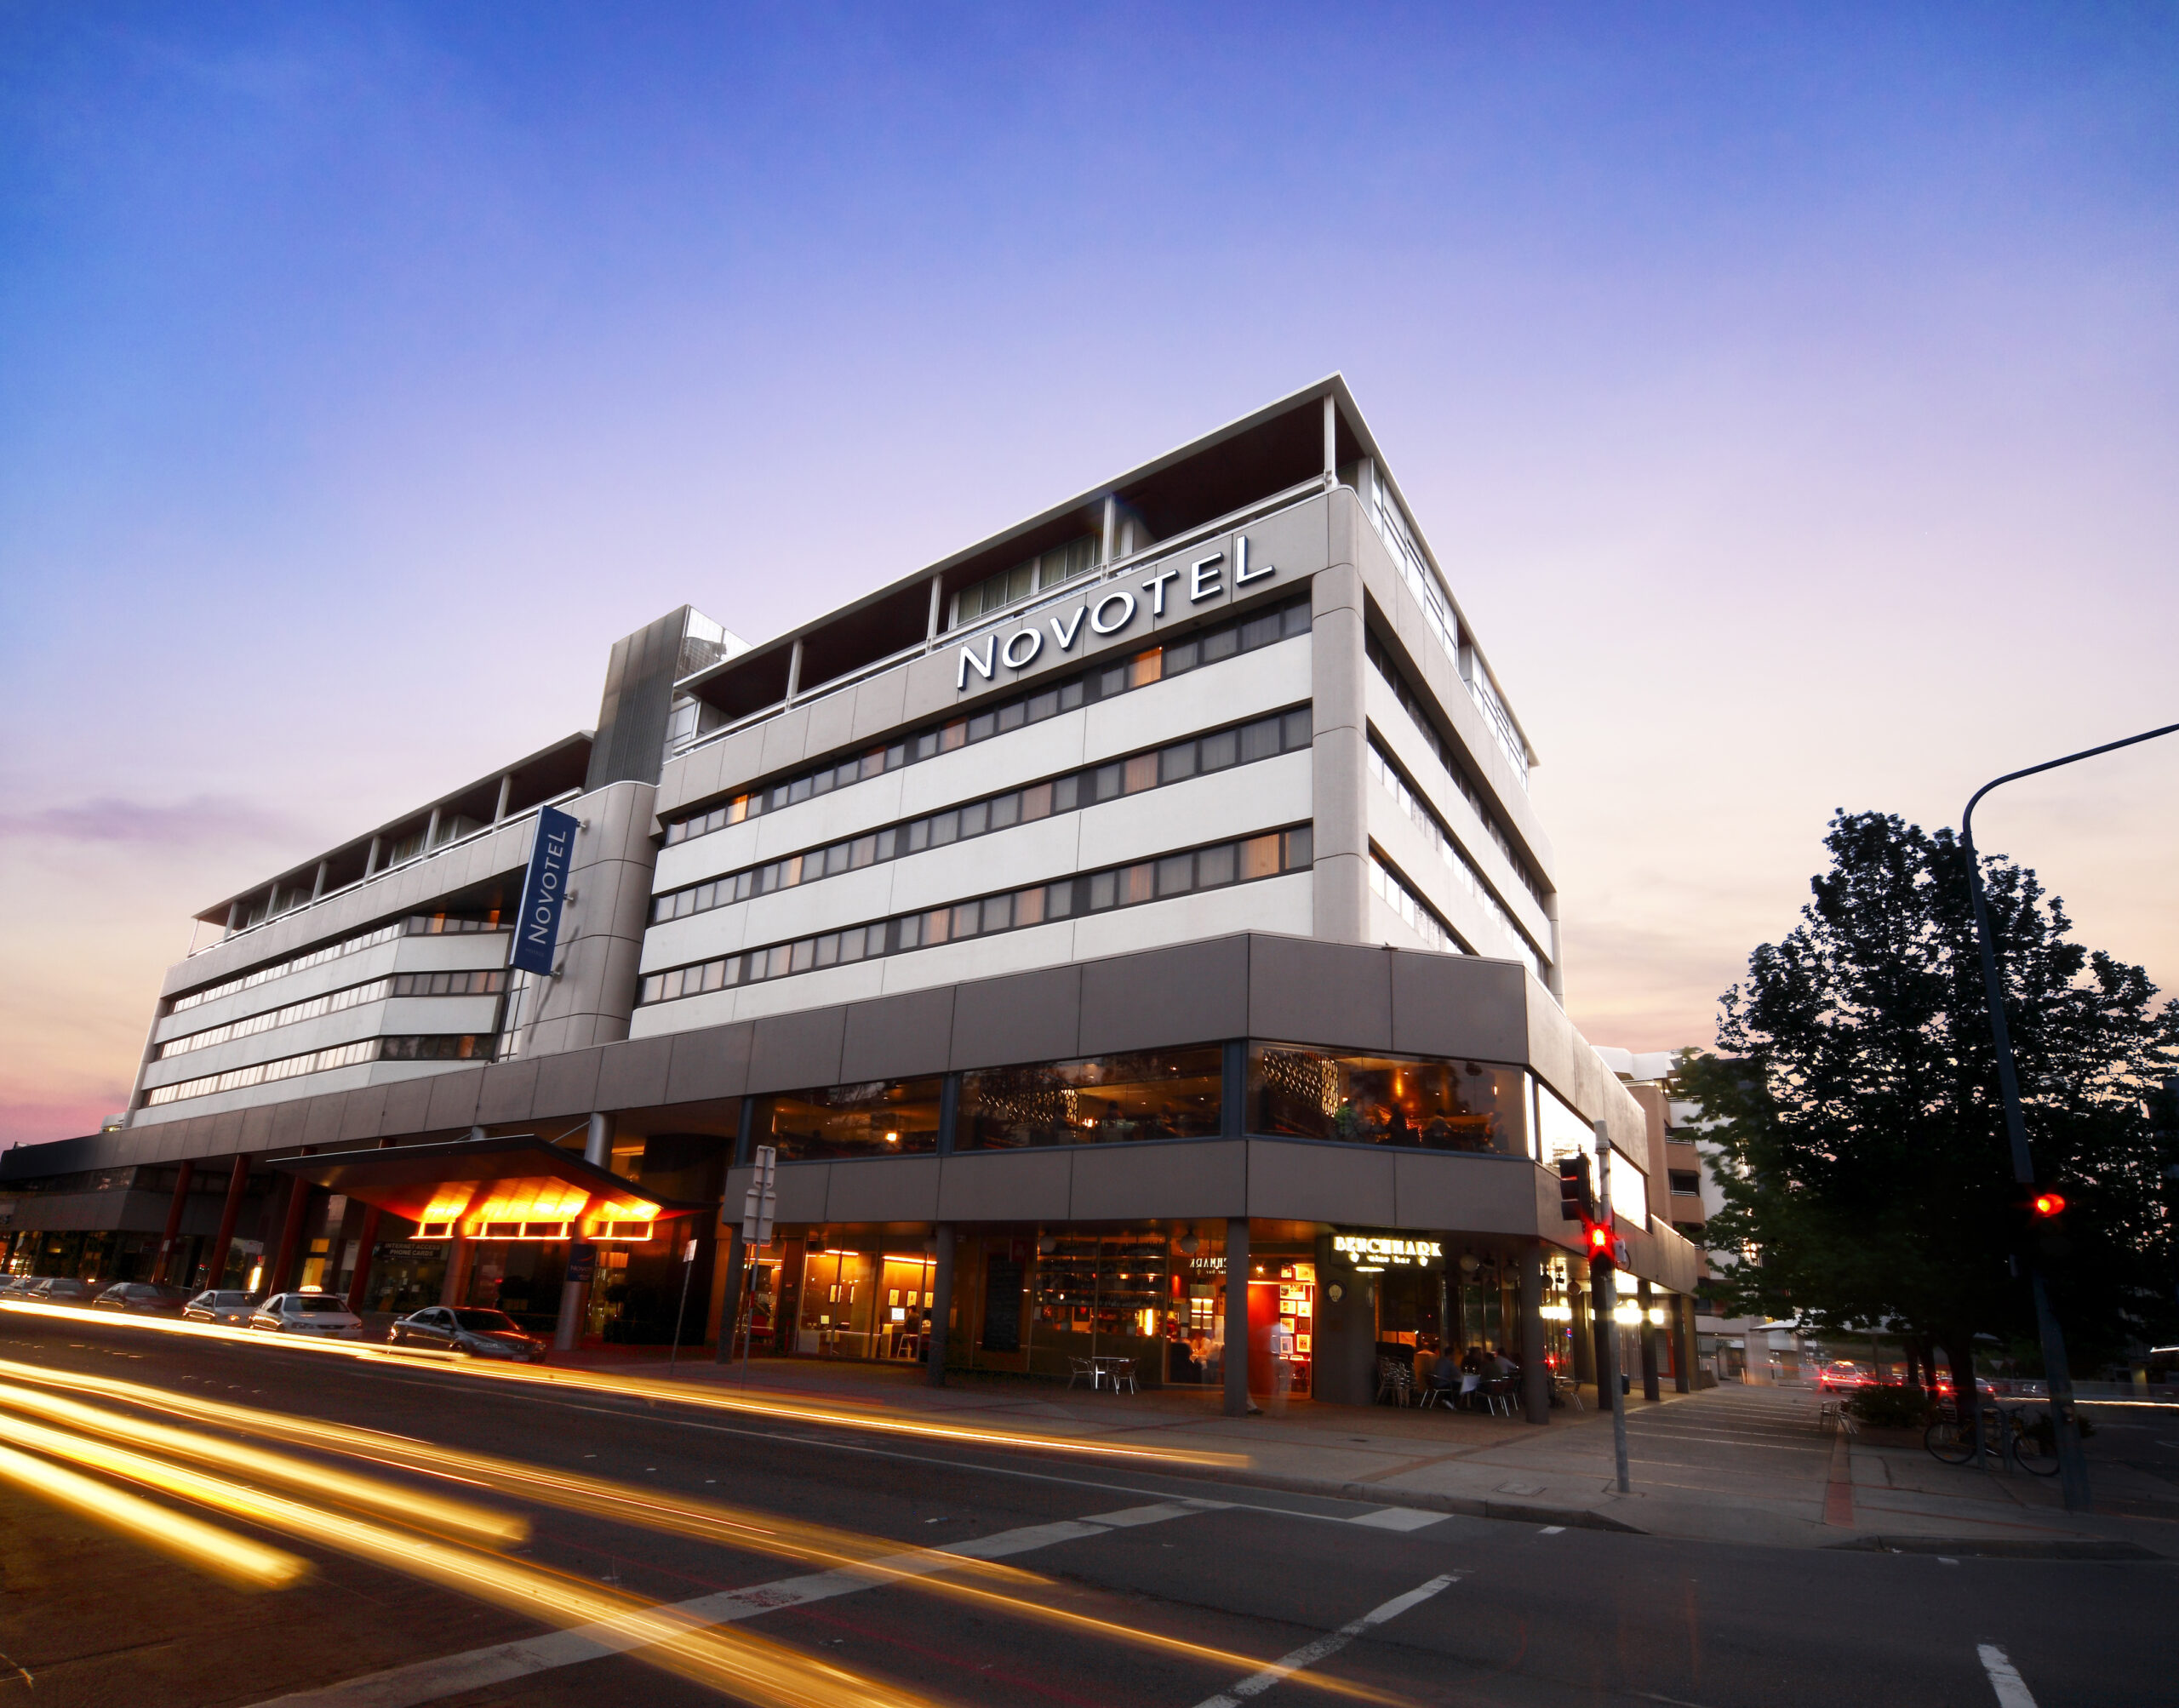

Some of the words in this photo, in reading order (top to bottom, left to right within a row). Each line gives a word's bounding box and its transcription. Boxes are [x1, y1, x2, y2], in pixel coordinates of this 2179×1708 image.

[957, 534, 1275, 690] NOVOTEL
[528, 831, 567, 945] NOVOTEL
[1333, 1236, 1443, 1257] BENCHMARK
